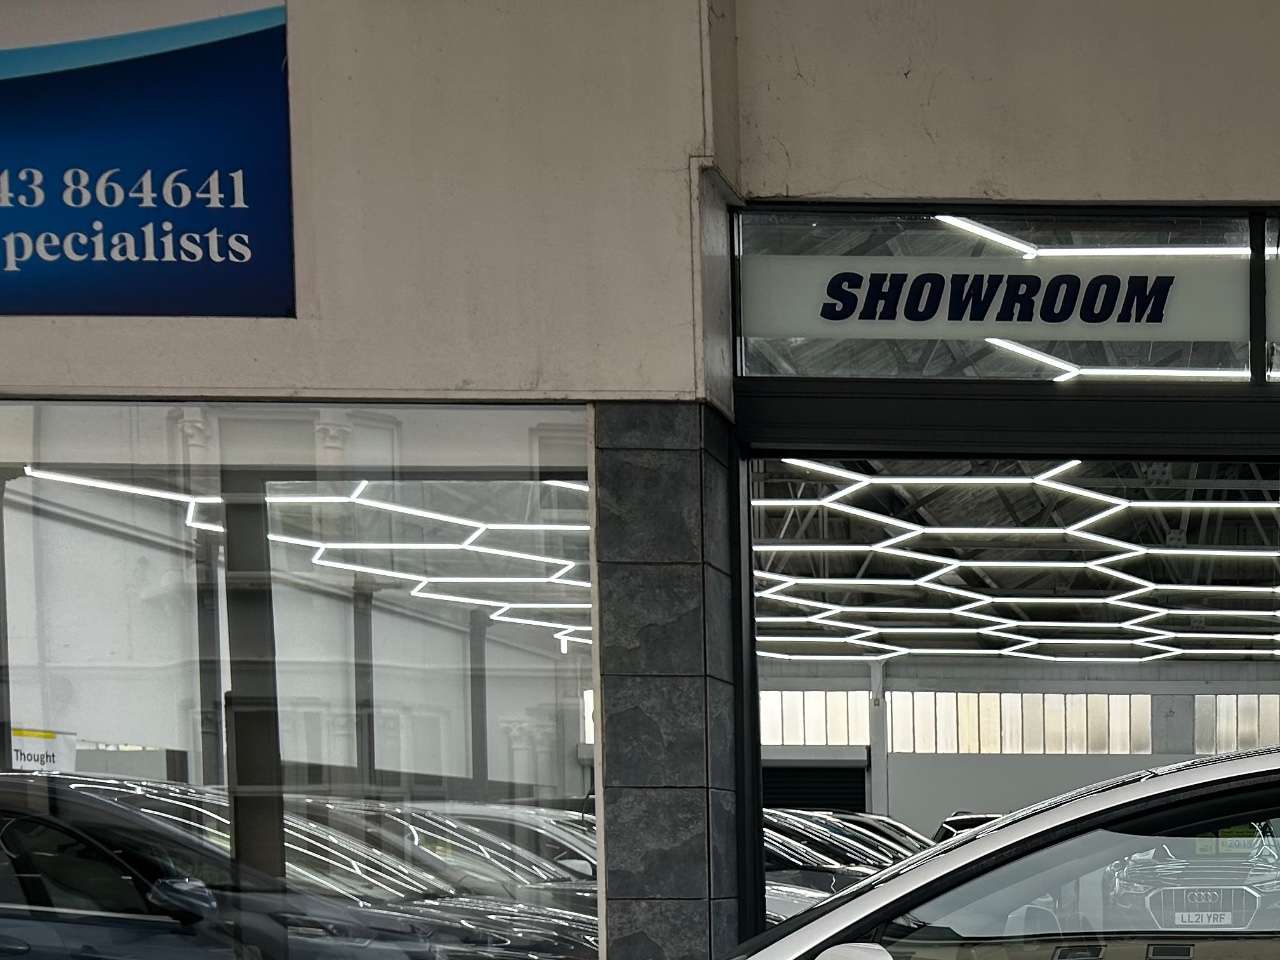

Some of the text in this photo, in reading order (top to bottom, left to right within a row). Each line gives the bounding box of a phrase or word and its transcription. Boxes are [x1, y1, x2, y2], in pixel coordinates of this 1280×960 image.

[62, 168, 249, 208] 864641
[2, 221, 253, 271] pecialists
[819, 272, 1176, 324] SHOWROOM
[13, 748, 56, 766] Thought
[1180, 913, 1226, 924] LL21 YRF
